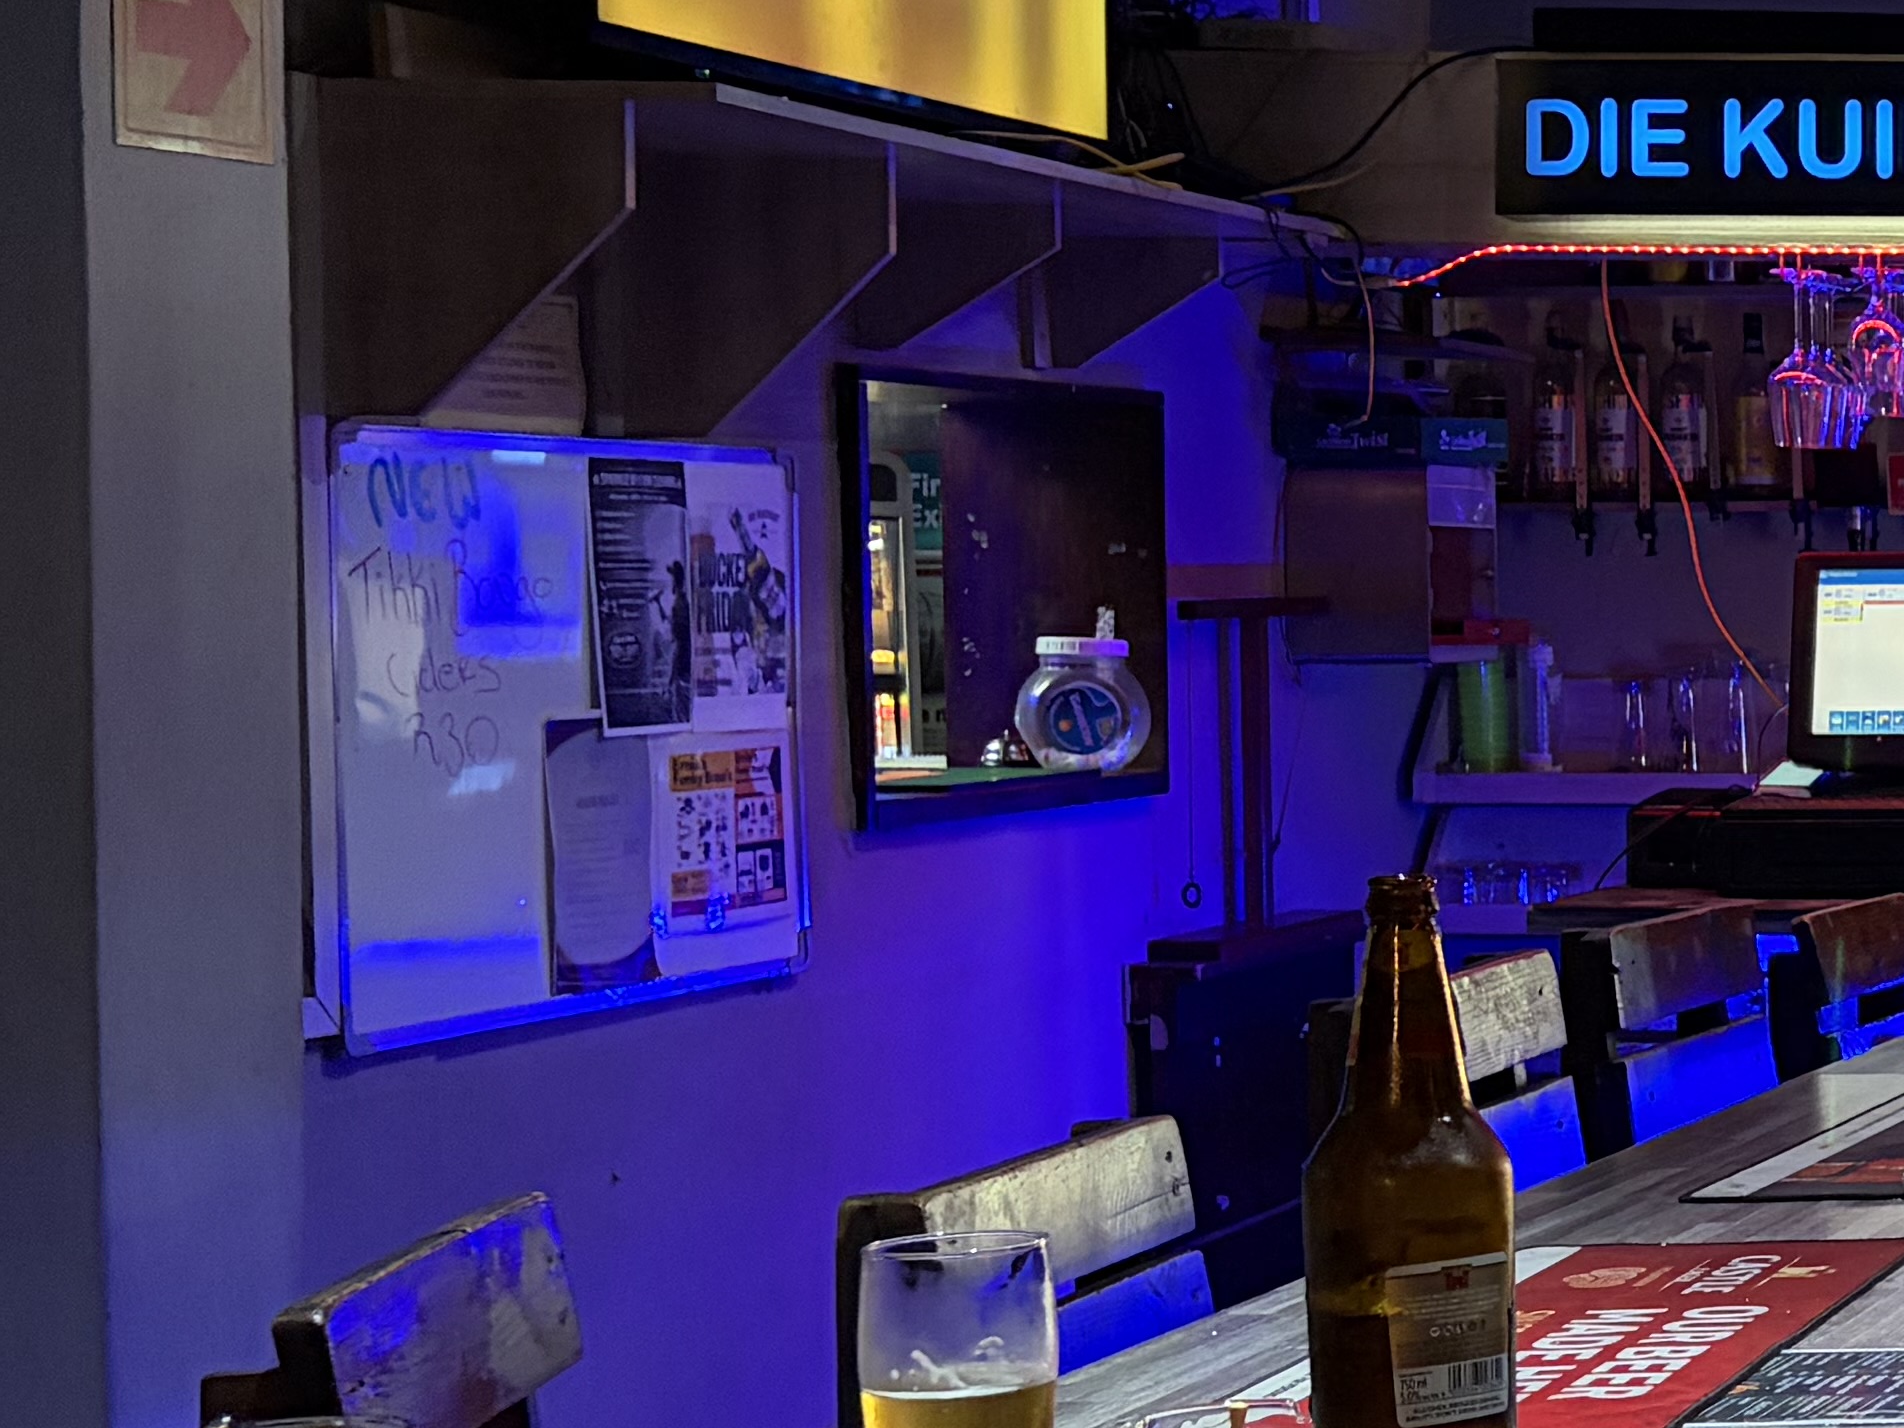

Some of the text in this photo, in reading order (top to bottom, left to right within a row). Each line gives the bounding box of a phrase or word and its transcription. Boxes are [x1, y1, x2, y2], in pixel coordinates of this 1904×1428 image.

[1525, 97, 1690, 179] DIE
[1680, 1254, 1782, 1295] CASTLE
[1637, 1304, 1770, 1345] OUR
[1547, 1344, 1713, 1401] BEER
